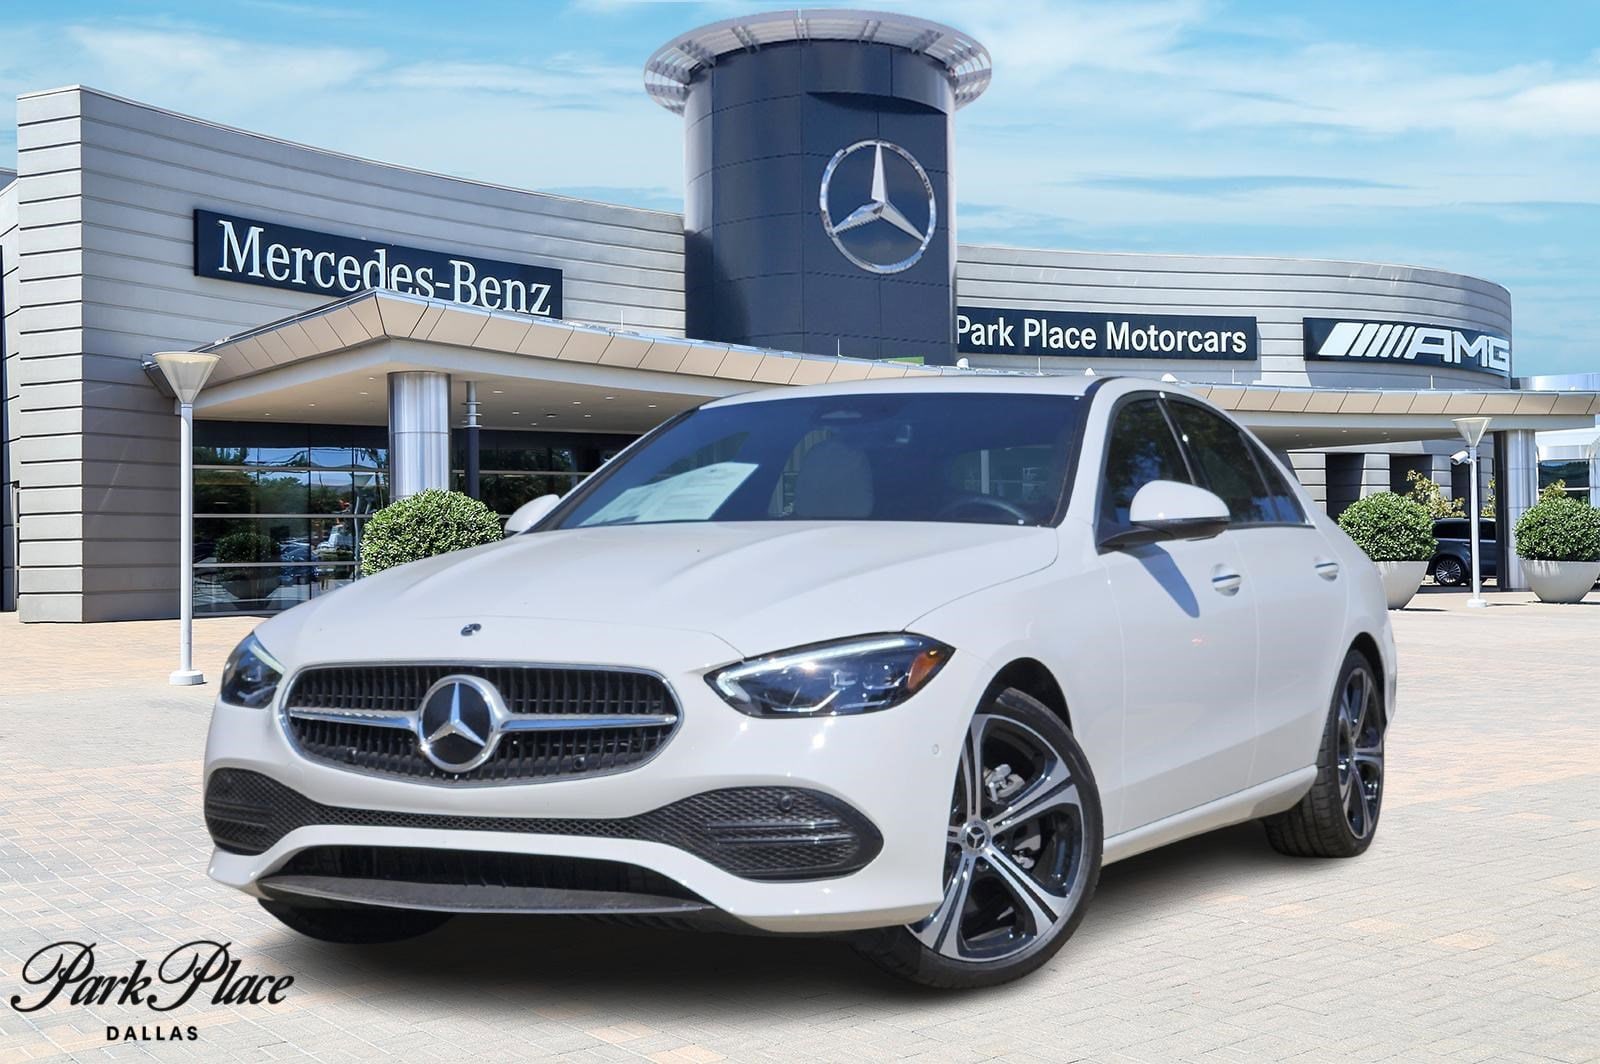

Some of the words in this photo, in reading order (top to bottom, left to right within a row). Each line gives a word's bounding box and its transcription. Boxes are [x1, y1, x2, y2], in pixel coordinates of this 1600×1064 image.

[217, 219, 552, 316] Mercedes-Benz
[957, 315, 1015, 348] Park
[1023, 319, 1097, 350] Place
[1106, 321, 1248, 354] Motorcars
